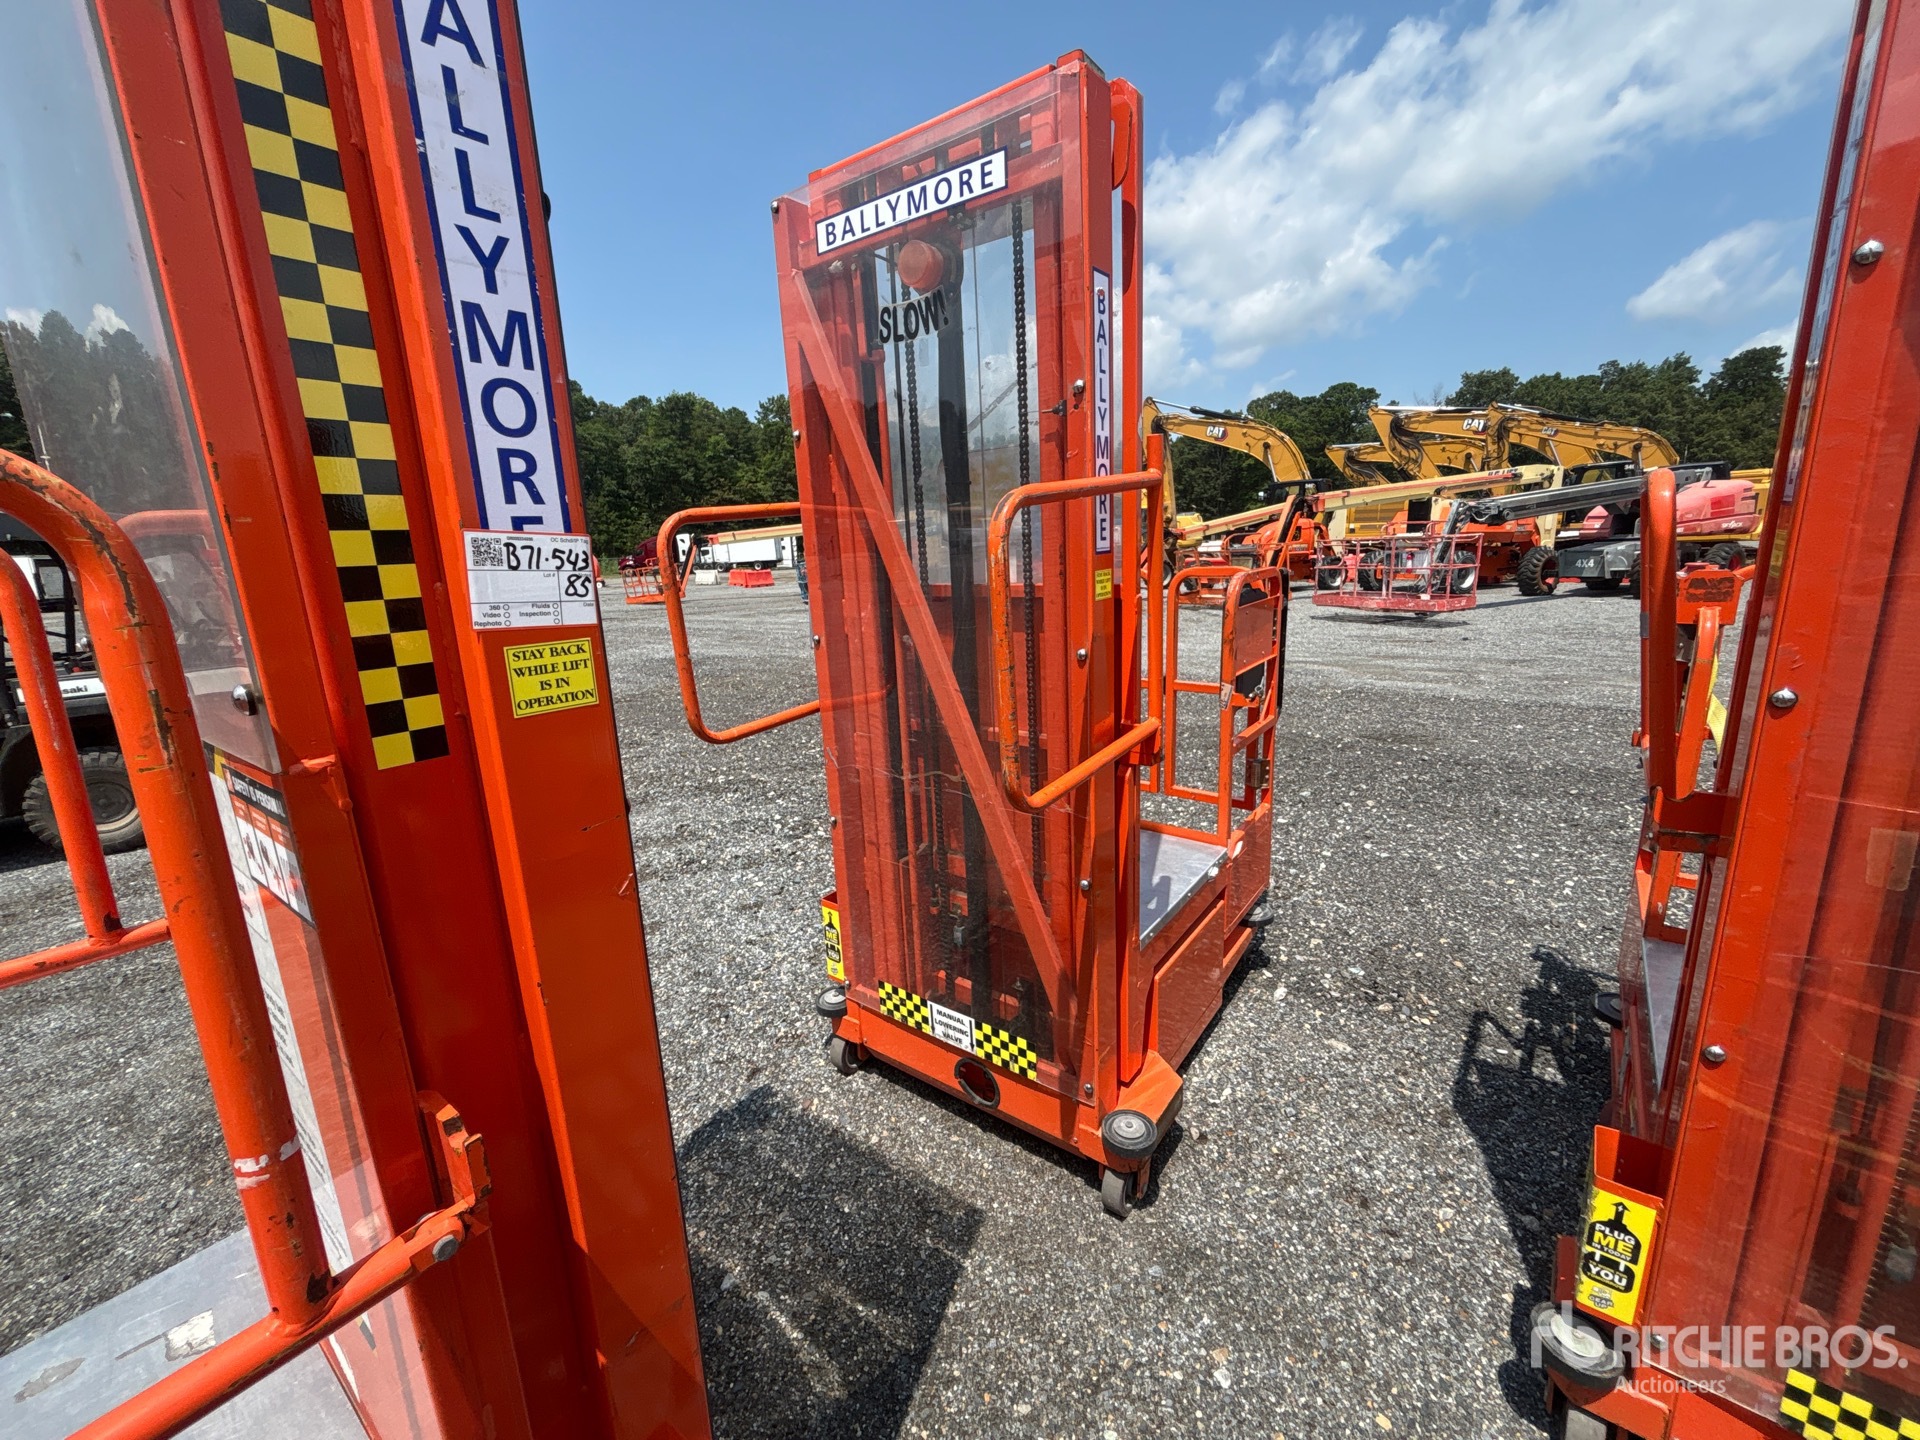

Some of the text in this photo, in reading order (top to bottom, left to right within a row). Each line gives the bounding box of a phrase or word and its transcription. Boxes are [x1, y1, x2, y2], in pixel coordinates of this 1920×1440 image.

[825, 159, 994, 247] BALLYMORE
[879, 289, 949, 344] SLOW!
[1206, 426, 1225, 438] CAT
[1463, 418, 1486, 432] CAT
[1575, 559, 1595, 568] 4X4
[565, 573, 591, 597] 85
[512, 643, 587, 662] STAY BACK
[512, 658, 590, 678] WHILE LIFT
[539, 677, 570, 691] IS IN
[517, 689, 595, 710] OPERATION
[936, 1009, 965, 1026] MANUAL
[935, 1018, 969, 1037] LOWERING
[942, 1031, 962, 1044] VALVE
[1593, 1231, 1634, 1256] ME
[1595, 1223, 1635, 1245] PLUG
[1592, 1242, 1631, 1261] IN TODAY
[1588, 1263, 1627, 1287] YOU
